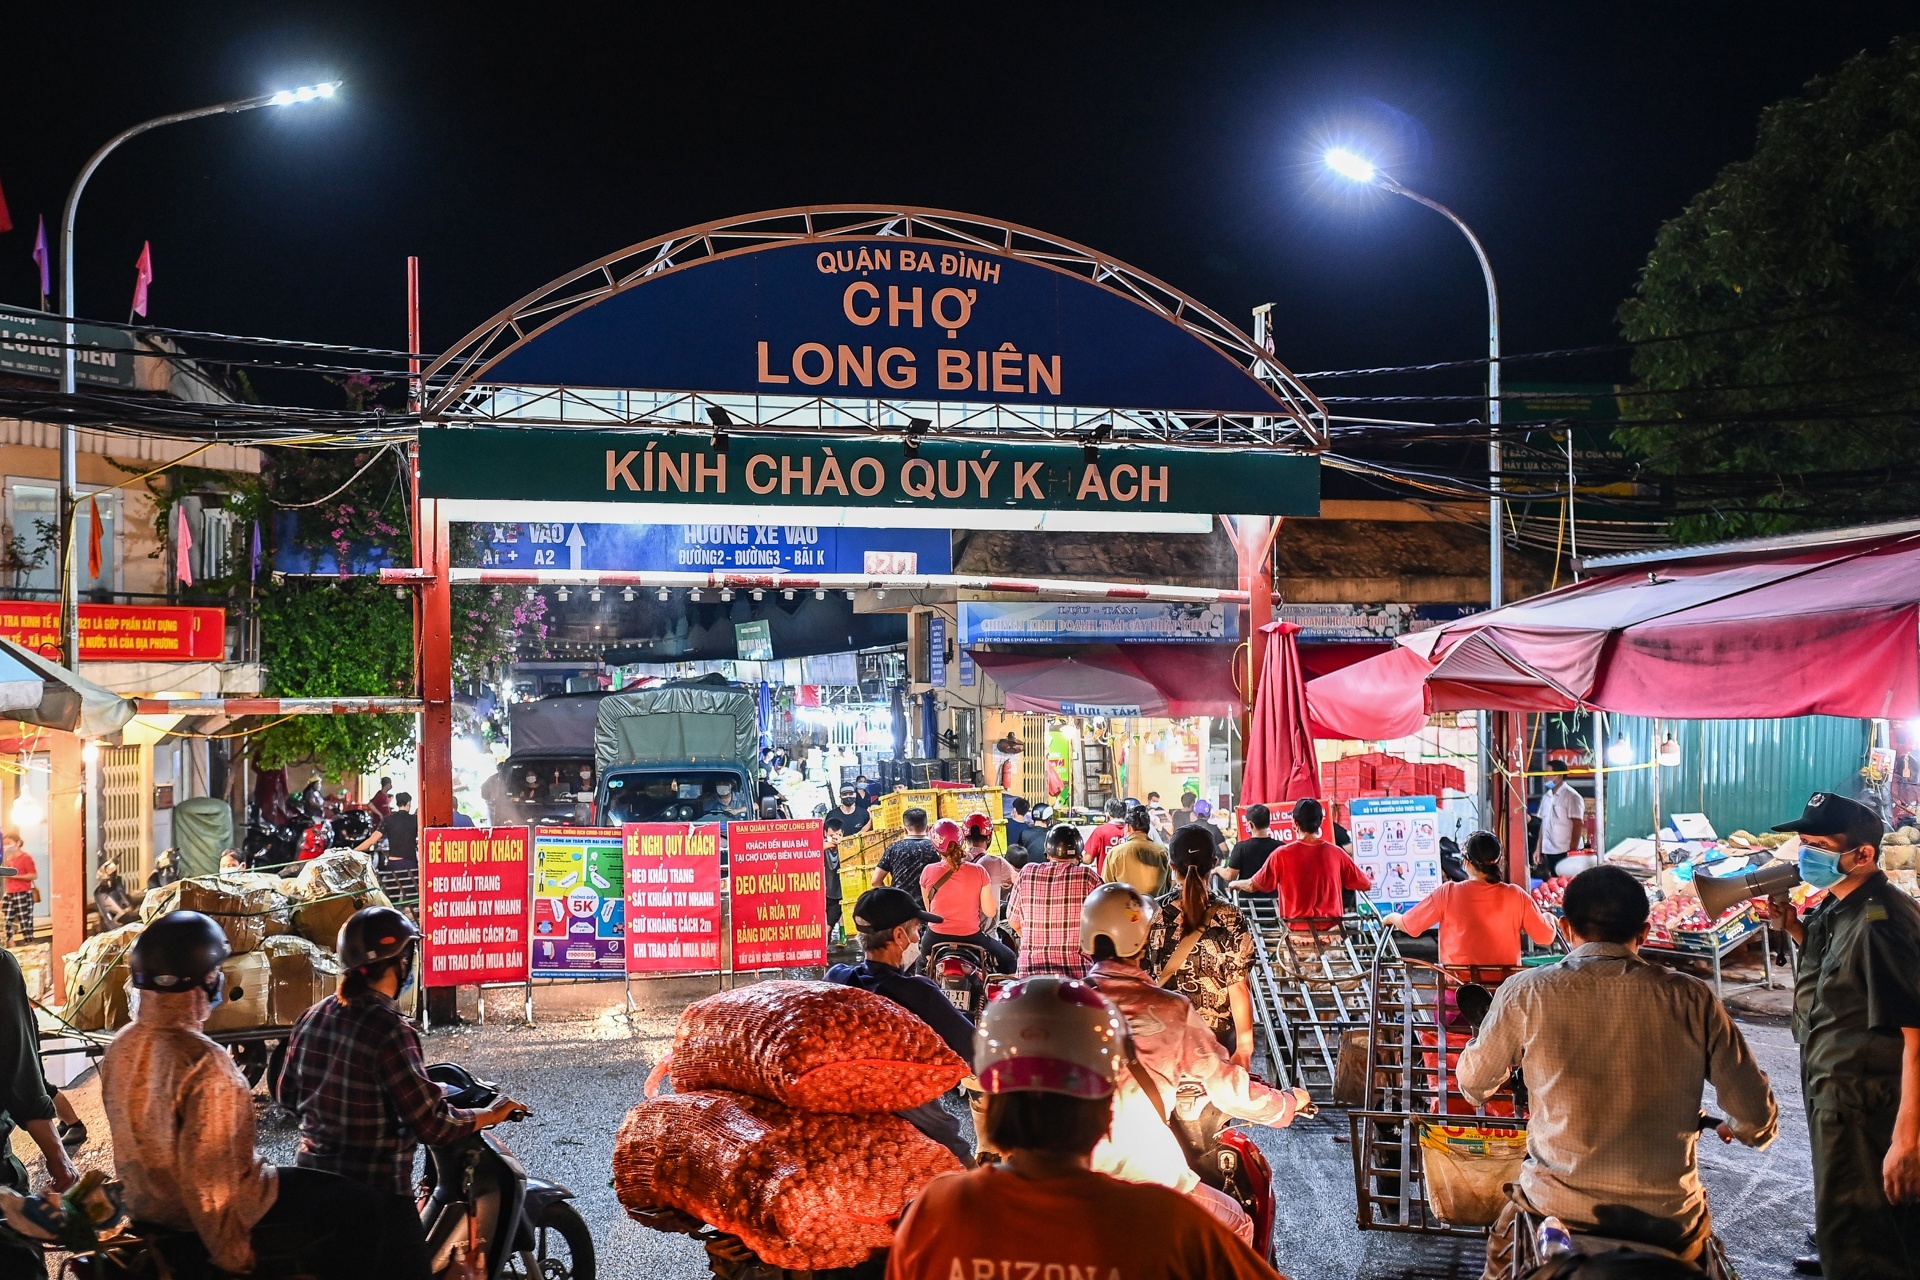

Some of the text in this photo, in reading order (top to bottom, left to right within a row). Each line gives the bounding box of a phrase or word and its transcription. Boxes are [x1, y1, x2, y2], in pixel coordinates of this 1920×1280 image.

[817, 246, 1001, 284] QUẬN BA ĐÌNH
[843, 281, 977, 339] CHỢ
[758, 341, 1061, 395] LONG BIÊN
[605, 441, 726, 493] KÍNH
[745, 446, 886, 496] CHÀO
[900, 449, 999, 499] QUÝ
[754, 526, 779, 545] XE
[534, 549, 555, 565] A2
[735, 545, 780, 566] ĐƯỜNG3
[794, 547, 812, 566] BÃI
[817, 550, 825, 565] K
[4, 615, 19, 627] TRA
[21, 616, 40, 628] KINH
[104, 616, 119, 631] GÓP
[1026, 619, 1056, 632] KINH
[1058, 619, 1098, 632] DOANH
[1297, 616, 1327, 627] DOANH
[736, 825, 748, 833] BAN
[767, 824, 774, 832] LÝ
[775, 824, 788, 832] CHỢ
[806, 822, 820, 830] BIÊN
[429, 833, 524, 867] ĐỀ NGHỊ QUÝ KHÁCH
[627, 828, 715, 860] ĐỀ NGHỊ QUÝ KHÁCH
[745, 838, 809, 850] KHÁCH ĐẾN MUA BÁN
[734, 849, 821, 864] TẠI CHỢ LONG BIÊN VUI LÒNG
[433, 870, 500, 893] ĐEO KHẨU TRANG
[632, 863, 694, 884] ĐEO KHẨU TRANG
[736, 862, 821, 895] ĐEO KHẨU TRANG
[433, 899, 448, 918] SÁT
[449, 895, 476, 917] KHUẨN
[478, 901, 493, 916] TAY
[494, 899, 521, 916] NHANH
[573, 900, 593, 913] 5K
[632, 886, 714, 907] SÁT KHUẨN TAY NHANH
[757, 900, 801, 921] VÀ RỬA TAY
[432, 922, 518, 945] GIỮ KHOẢNG CÁCH 2m
[632, 912, 712, 934] GIỮ KHOẢNG CÁCH 2m
[737, 915, 821, 946] BẰNG DỊCH SÁT KHUẨN
[634, 937, 717, 958] KHI TRAO ĐỔI MUA BÁN
[432, 948, 523, 971] KHI TRAO ĐỔI MUA BÁN
[949, 1256, 1121, 1280] ARIZONA
